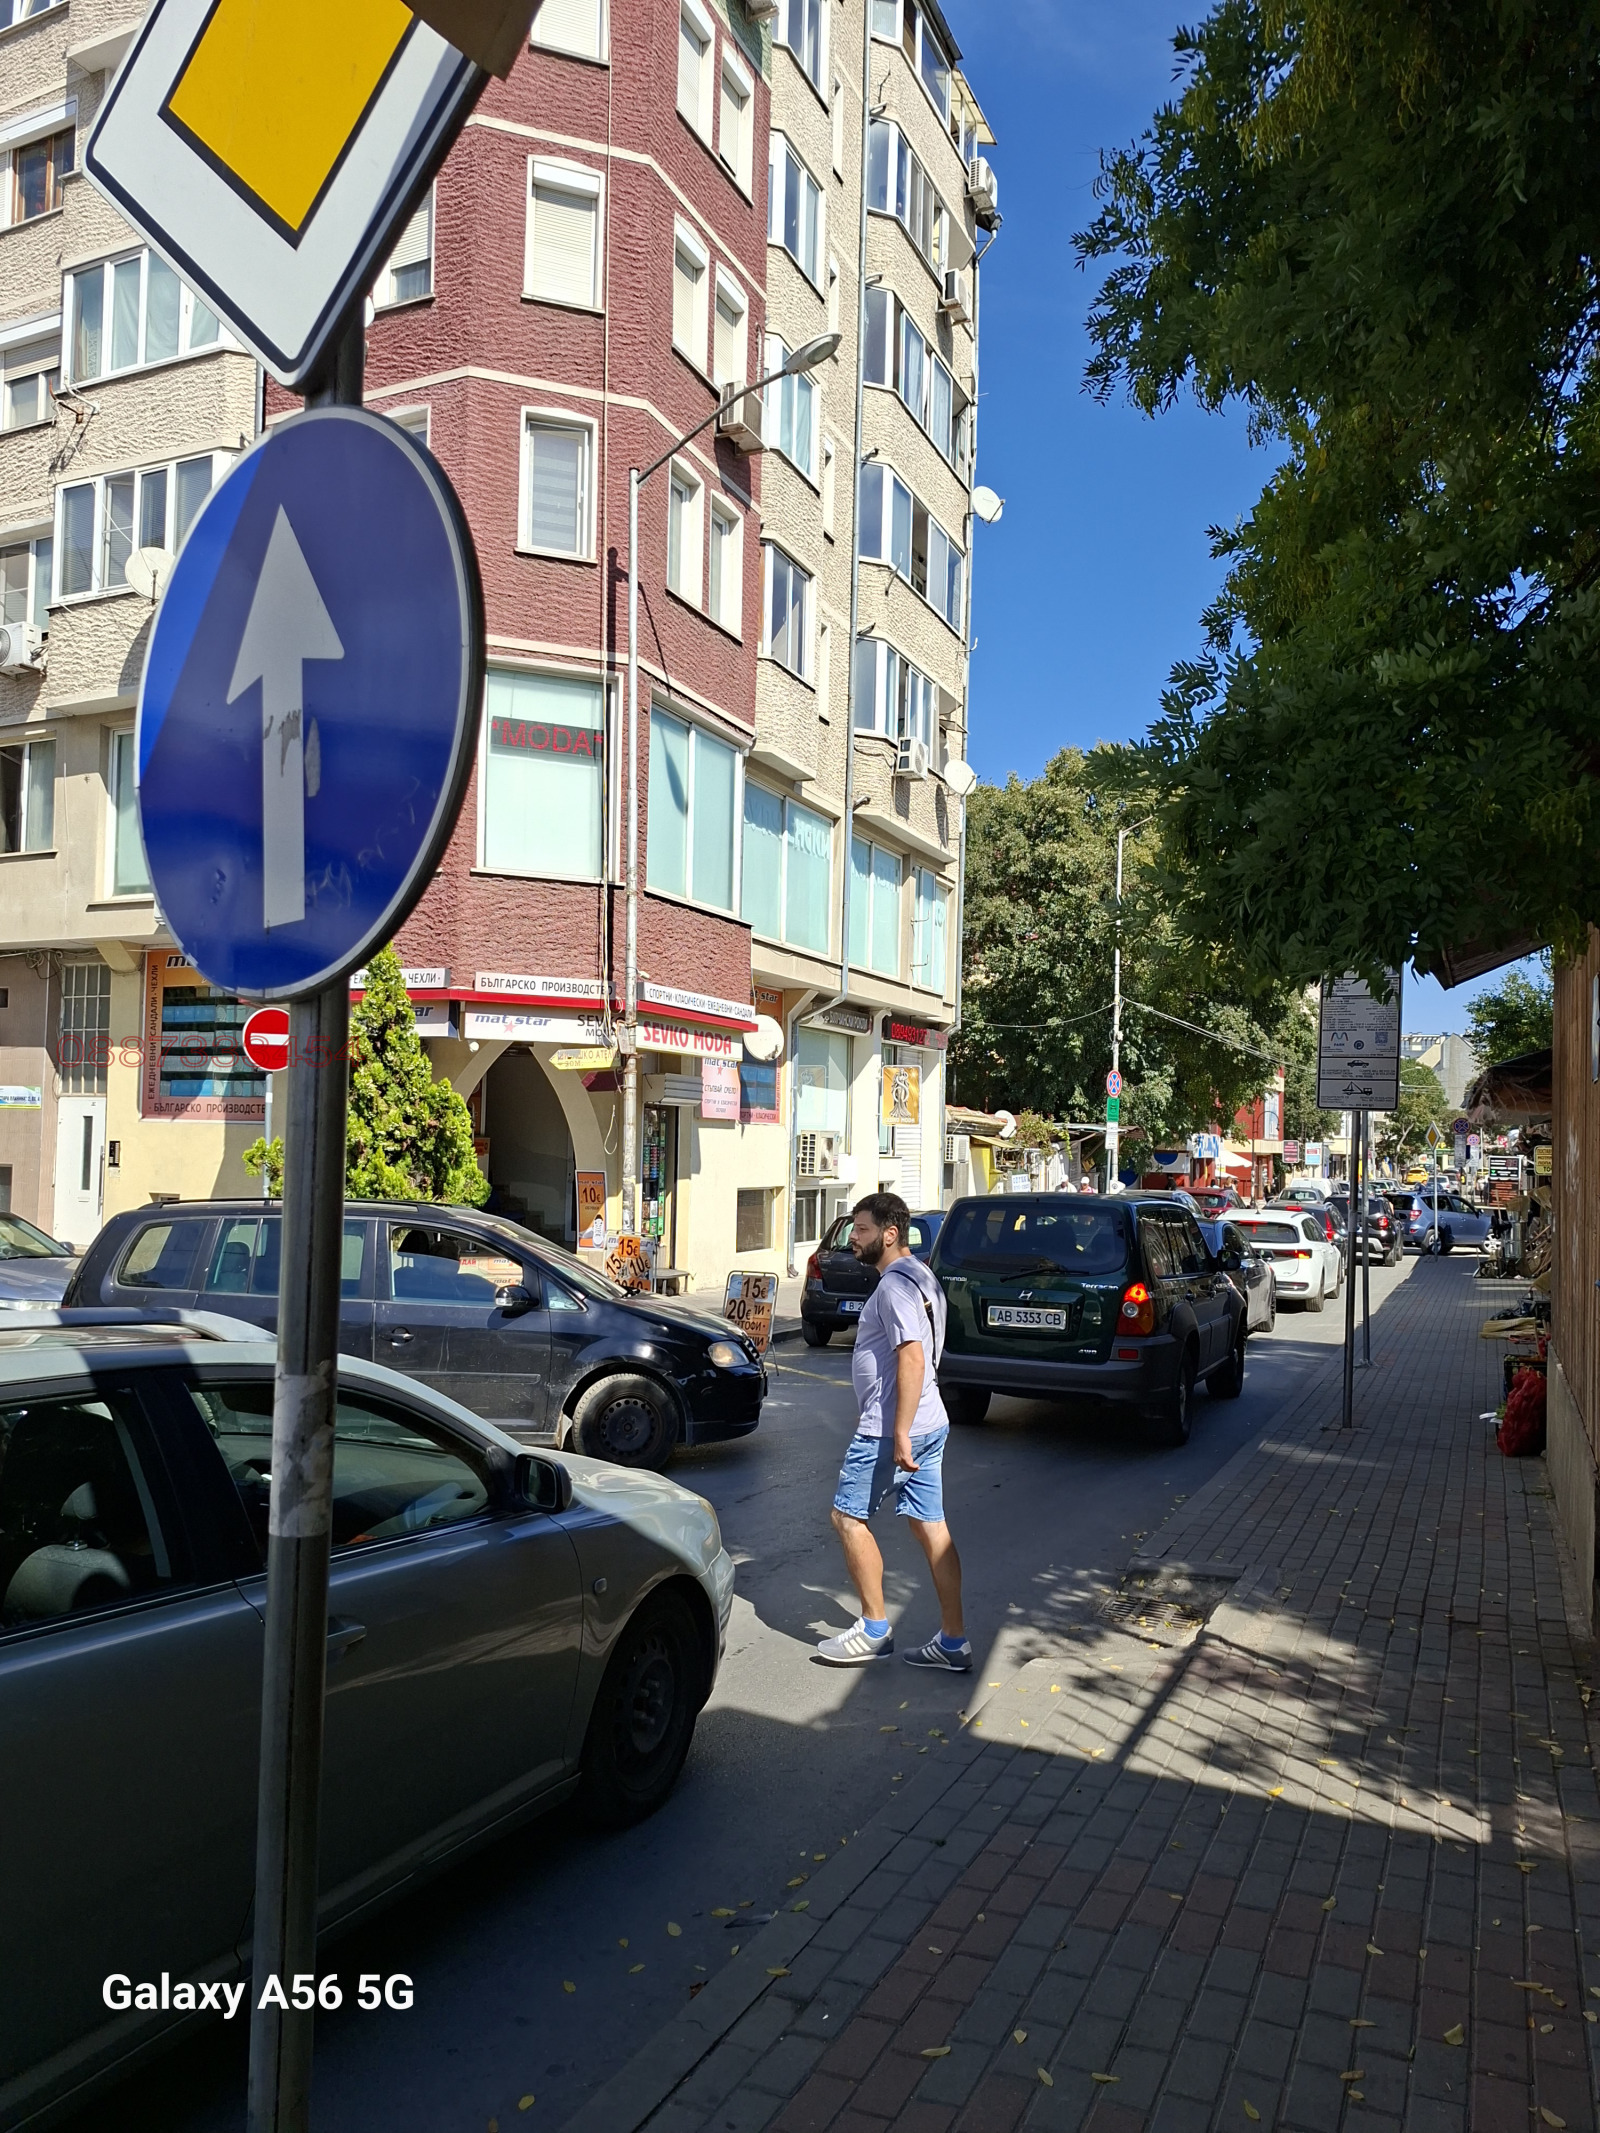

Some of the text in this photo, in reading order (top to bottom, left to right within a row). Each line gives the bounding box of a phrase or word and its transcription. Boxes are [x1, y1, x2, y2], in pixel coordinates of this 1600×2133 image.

[151, 964, 159, 991] ЧЕХЛИ
[408, 972, 436, 984] ЧЕХЛИ
[480, 976, 536, 991] БЪЛГАРСКО
[760, 992, 779, 1003] star
[149, 997, 158, 1036] САНДАЛИ
[474, 1013, 552, 1027] mat star
[643, 1020, 732, 1055] SEVKO MODA
[153, 1102, 202, 1114] БЪЛГАРСКО
[582, 1187, 601, 1203] 10€
[619, 1238, 639, 1256] 15€
[743, 1277, 767, 1298] 15€
[1081, 1282, 1119, 1290] Terracan
[727, 1299, 752, 1320] 20€
[996, 1310, 1061, 1326] AB 5353 CB
